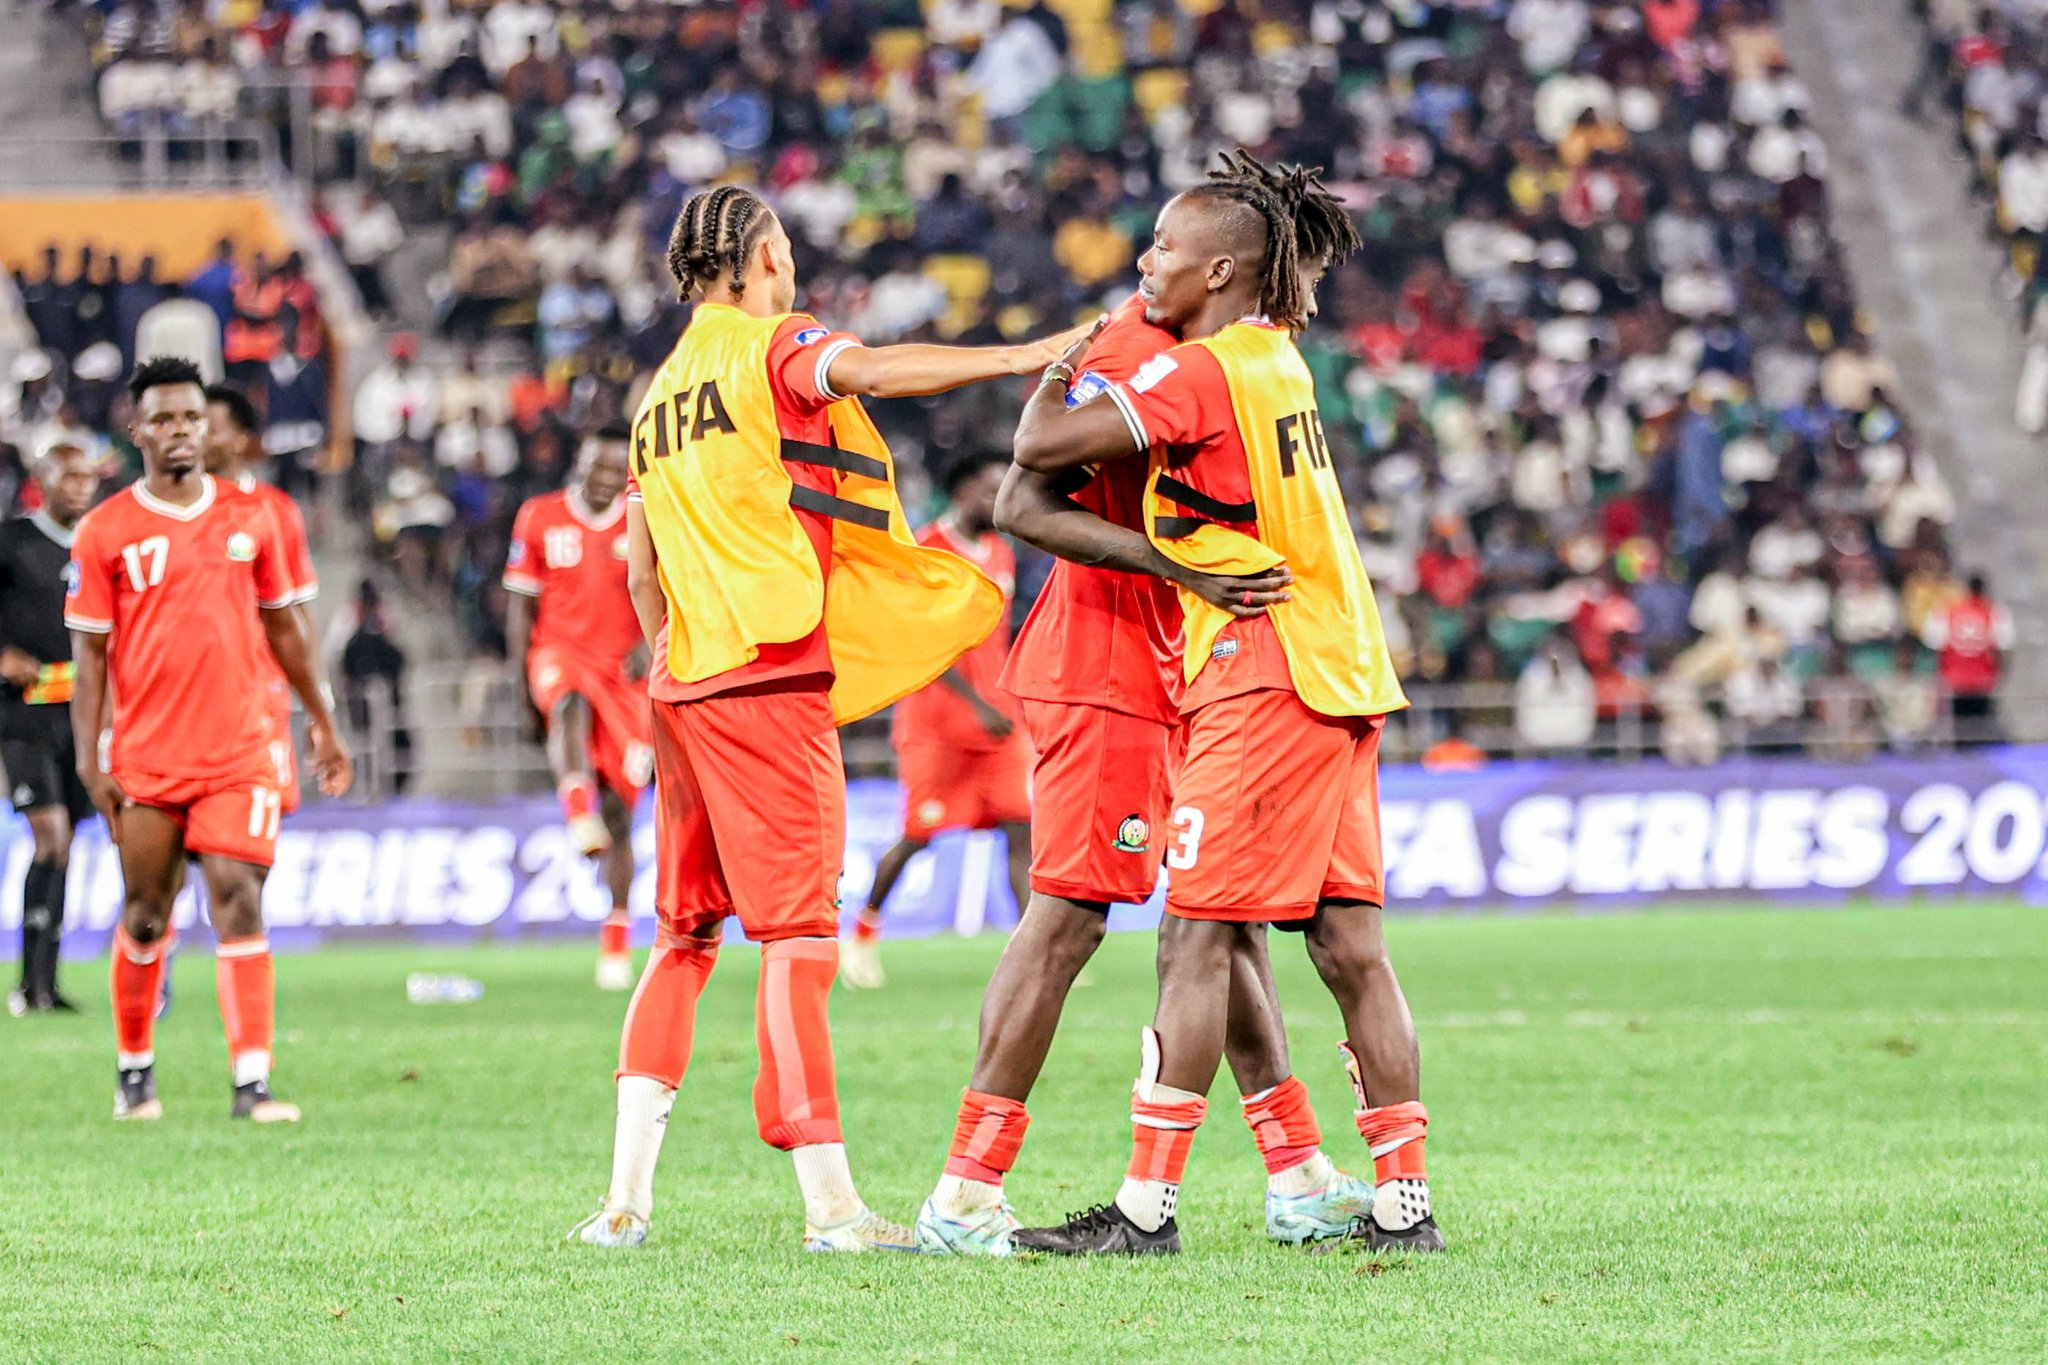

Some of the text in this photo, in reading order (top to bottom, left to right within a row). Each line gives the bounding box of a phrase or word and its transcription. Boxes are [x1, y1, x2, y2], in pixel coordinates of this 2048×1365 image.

[635, 379, 738, 477] FIFA
[121, 535, 170, 593] 17
[203, 825, 517, 928] ERIES
[1168, 806, 1205, 870] 3
[1494, 784, 1890, 898] SERIES
[1895, 779, 2048, 886] 20
